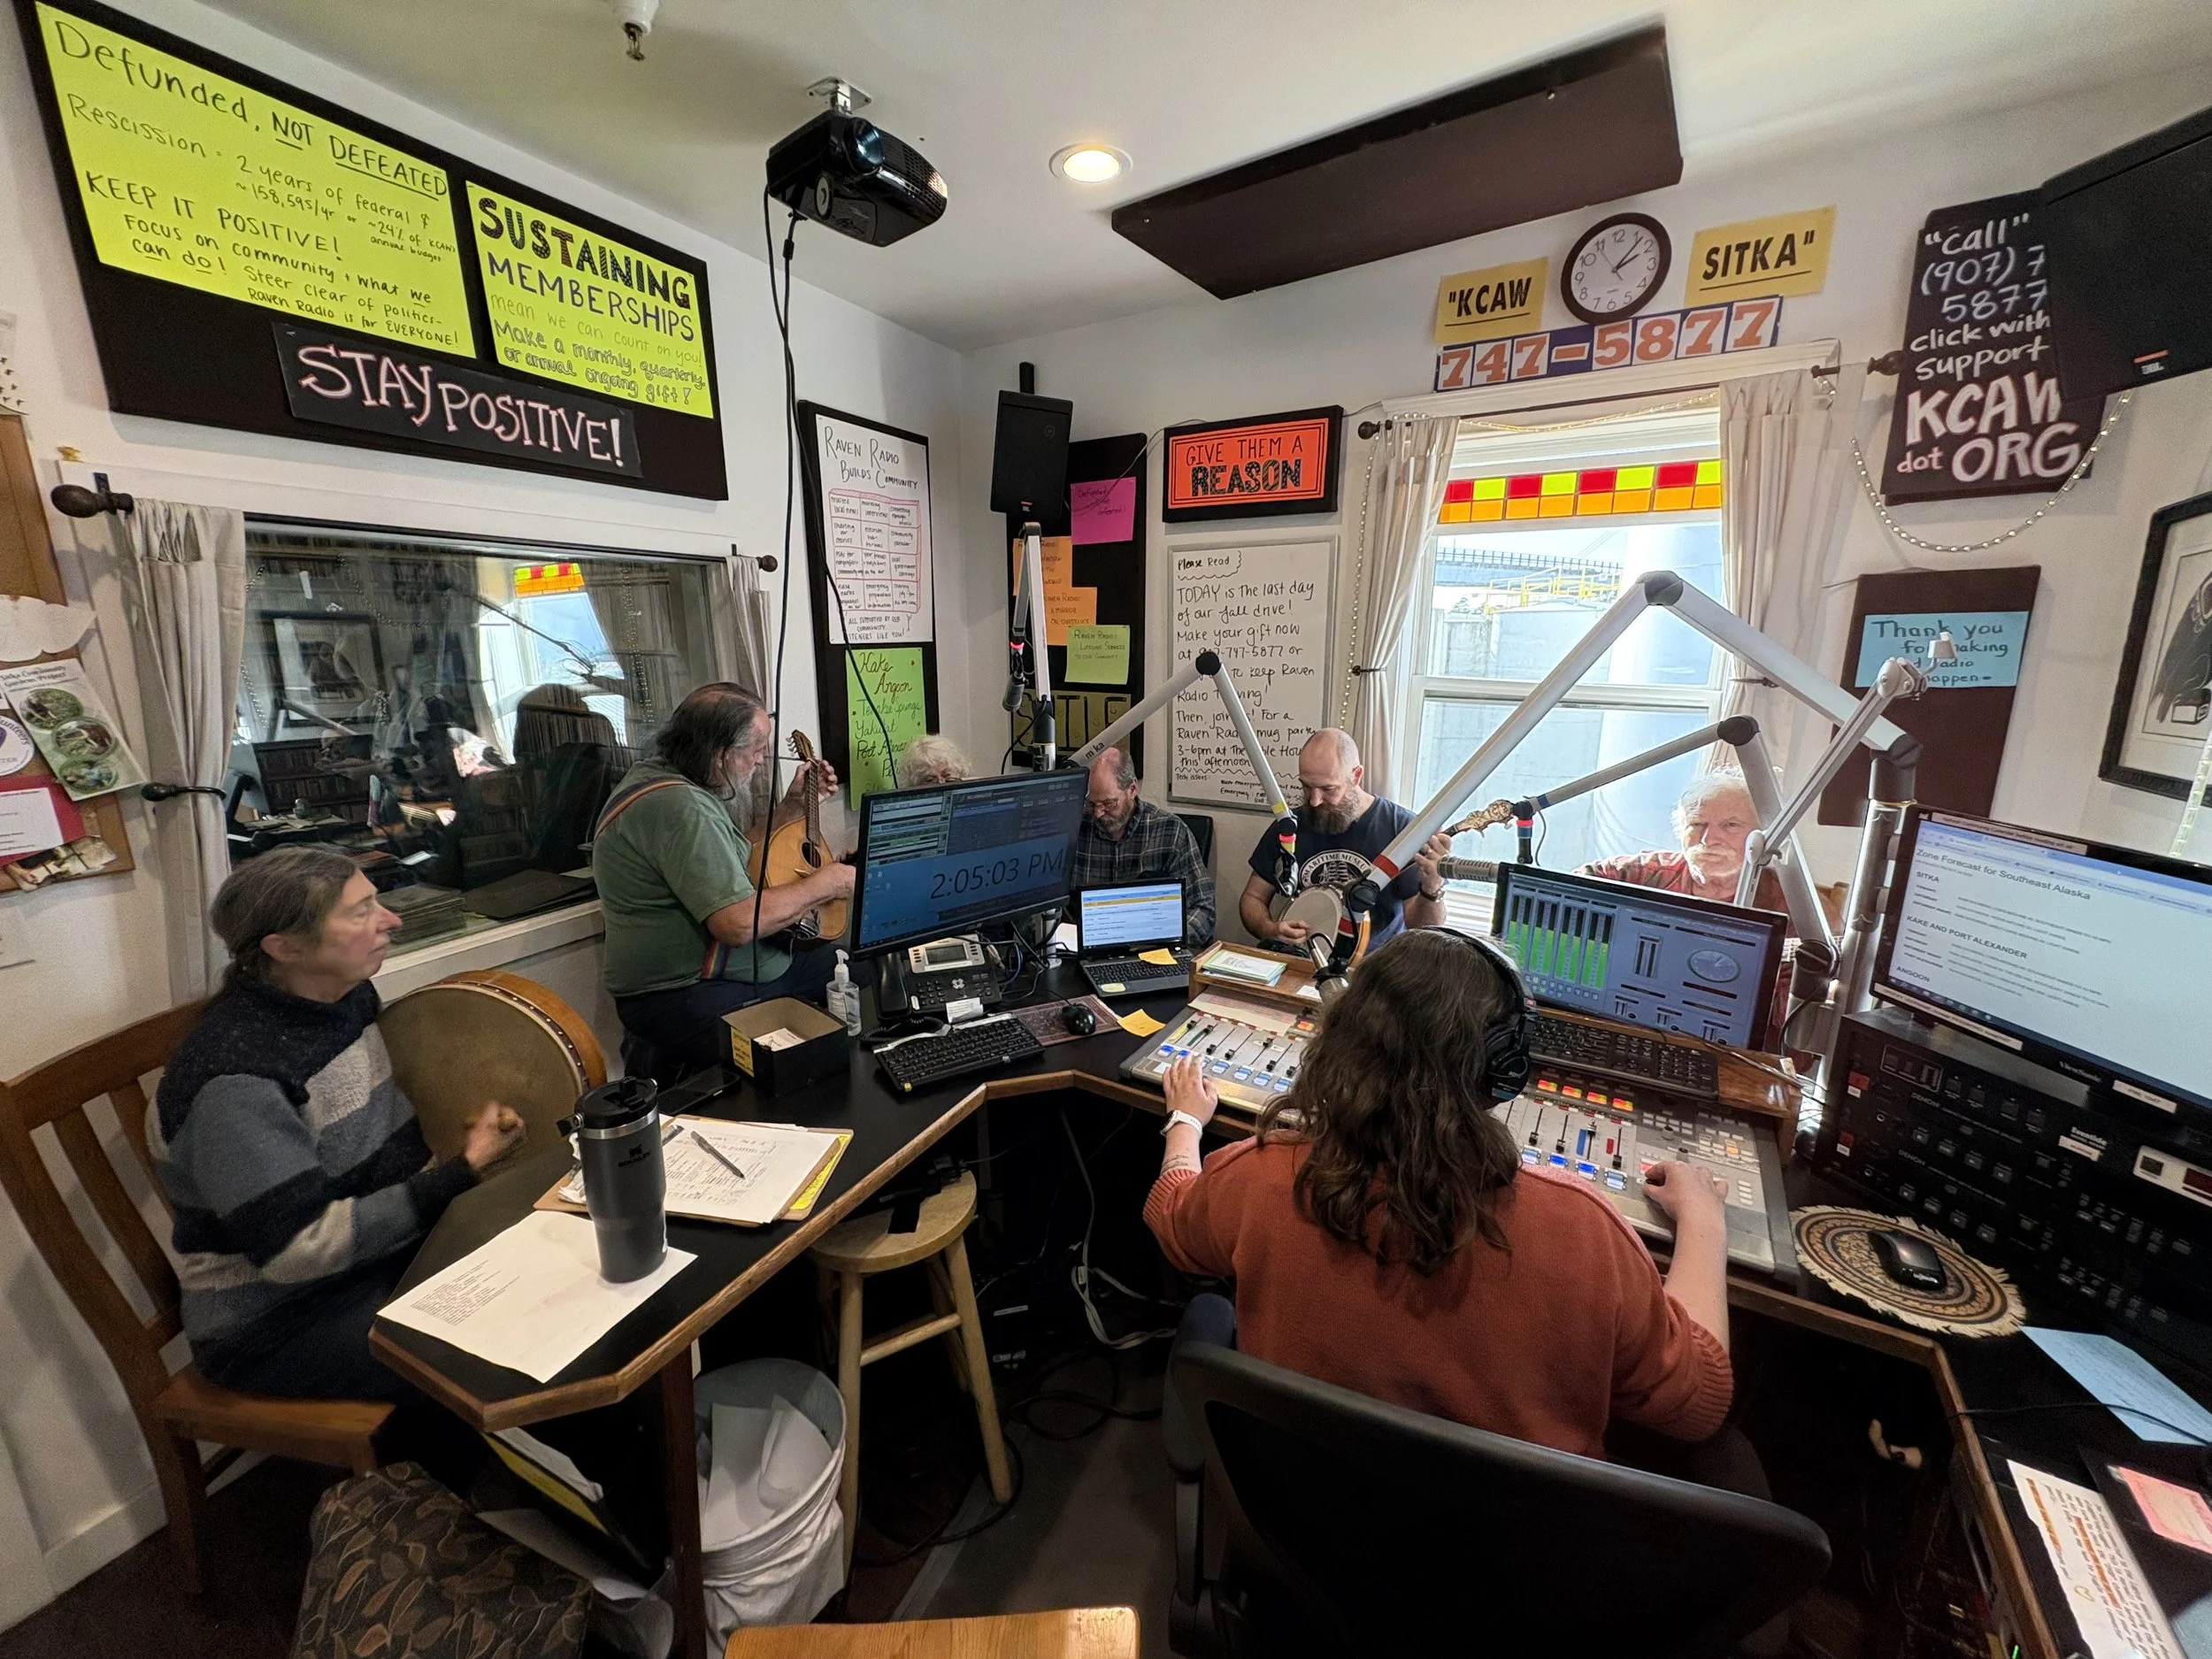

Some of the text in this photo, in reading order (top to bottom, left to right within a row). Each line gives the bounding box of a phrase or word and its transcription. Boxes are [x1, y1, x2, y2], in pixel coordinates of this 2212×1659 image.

[67, 93, 205, 157] Rescission
[236, 155, 251, 173] 2
[259, 164, 311, 193] years
[326, 188, 343, 205] of
[356, 195, 410, 223] federal
[272, 111, 314, 146] NOT
[329, 134, 447, 196] DEFEATED
[86, 171, 342, 261] KEEP IT POSITIVE!
[371, 235, 404, 253] annual
[410, 234, 421, 246] of
[1594, 239, 1605, 252] 11
[1612, 229, 1625, 243] 12
[1643, 239, 1654, 254] 2
[478, 197, 691, 310] SUSTAINING
[1579, 252, 1597, 267] 10
[1647, 257, 1657, 271] 3
[1701, 229, 1816, 280] SITKA"
[133, 239, 172, 260] can
[182, 250, 227, 276] do!
[243, 266, 293, 290] Steer
[304, 283, 348, 303] clear
[358, 297, 374, 311] of
[196, 234, 220, 250] on
[232, 242, 335, 283] community
[357, 275, 399, 296] what
[411, 289, 432, 306] we
[1575, 271, 1585, 285] 9
[1921, 246, 2016, 296] (907)
[1579, 287, 1588, 301] 8
[1637, 277, 1647, 289] 4
[488, 251, 695, 342] MEMBERSHIPS
[1448, 276, 1532, 318] "KCAW
[1593, 296, 1601, 311] 7
[1607, 297, 1617, 311] 6
[1624, 291, 1632, 304] 5
[1940, 279, 2049, 322] 5877
[248, 287, 460, 349] Raven Radio is for EVERYONE!
[491, 293, 703, 368] mean we can count on you!
[494, 319, 547, 349] Make
[553, 338, 565, 354] a
[1909, 309, 2052, 353] click with
[1440, 302, 1775, 388] 747-5877
[504, 346, 692, 405] or annual ongoing gift!
[297, 343, 625, 468] STAY POSITIVE!
[1905, 369, 2063, 447] KCAW
[1186, 434, 1303, 466] GIVE THEM A
[1896, 421, 2080, 483] dot ORG
[1192, 458, 1302, 496] REASON
[1178, 556, 1230, 571] Please Read
[1176, 580, 1315, 604] TODAY is last day
[1177, 599, 1293, 627] of our fall drive!
[1177, 624, 1301, 647] Make your gift now
[1871, 619, 2003, 640] Thank you
[859, 652, 894, 673] Kake
[1178, 646, 1304, 660] at or
[1249, 666, 1276, 687] keep
[1281, 664, 1315, 676] Raven
[1177, 688, 1209, 703] Radio
[1262, 709, 1280, 721] For
[1283, 712, 1294, 721] a
[1176, 728, 1280, 742] Raven mug
[1178, 744, 1227, 760] 3-6pm at
[1204, 756, 1251, 769] afternoon
[930, 849, 1064, 899] 2:05:03 PM
[1304, 853, 1366, 875] MARITIME MUSEU
[1916, 849, 2091, 901] Zone Forecast for Southeast Alaska
[1916, 871, 1939, 883] SITKA
[1907, 915, 2027, 959] KAKE AND PORT ALEXANDER
[1896, 965, 1931, 983] ANGOON
[1911, 1092, 1939, 1107] DENON
[1899, 1149, 1925, 1166] DENON
